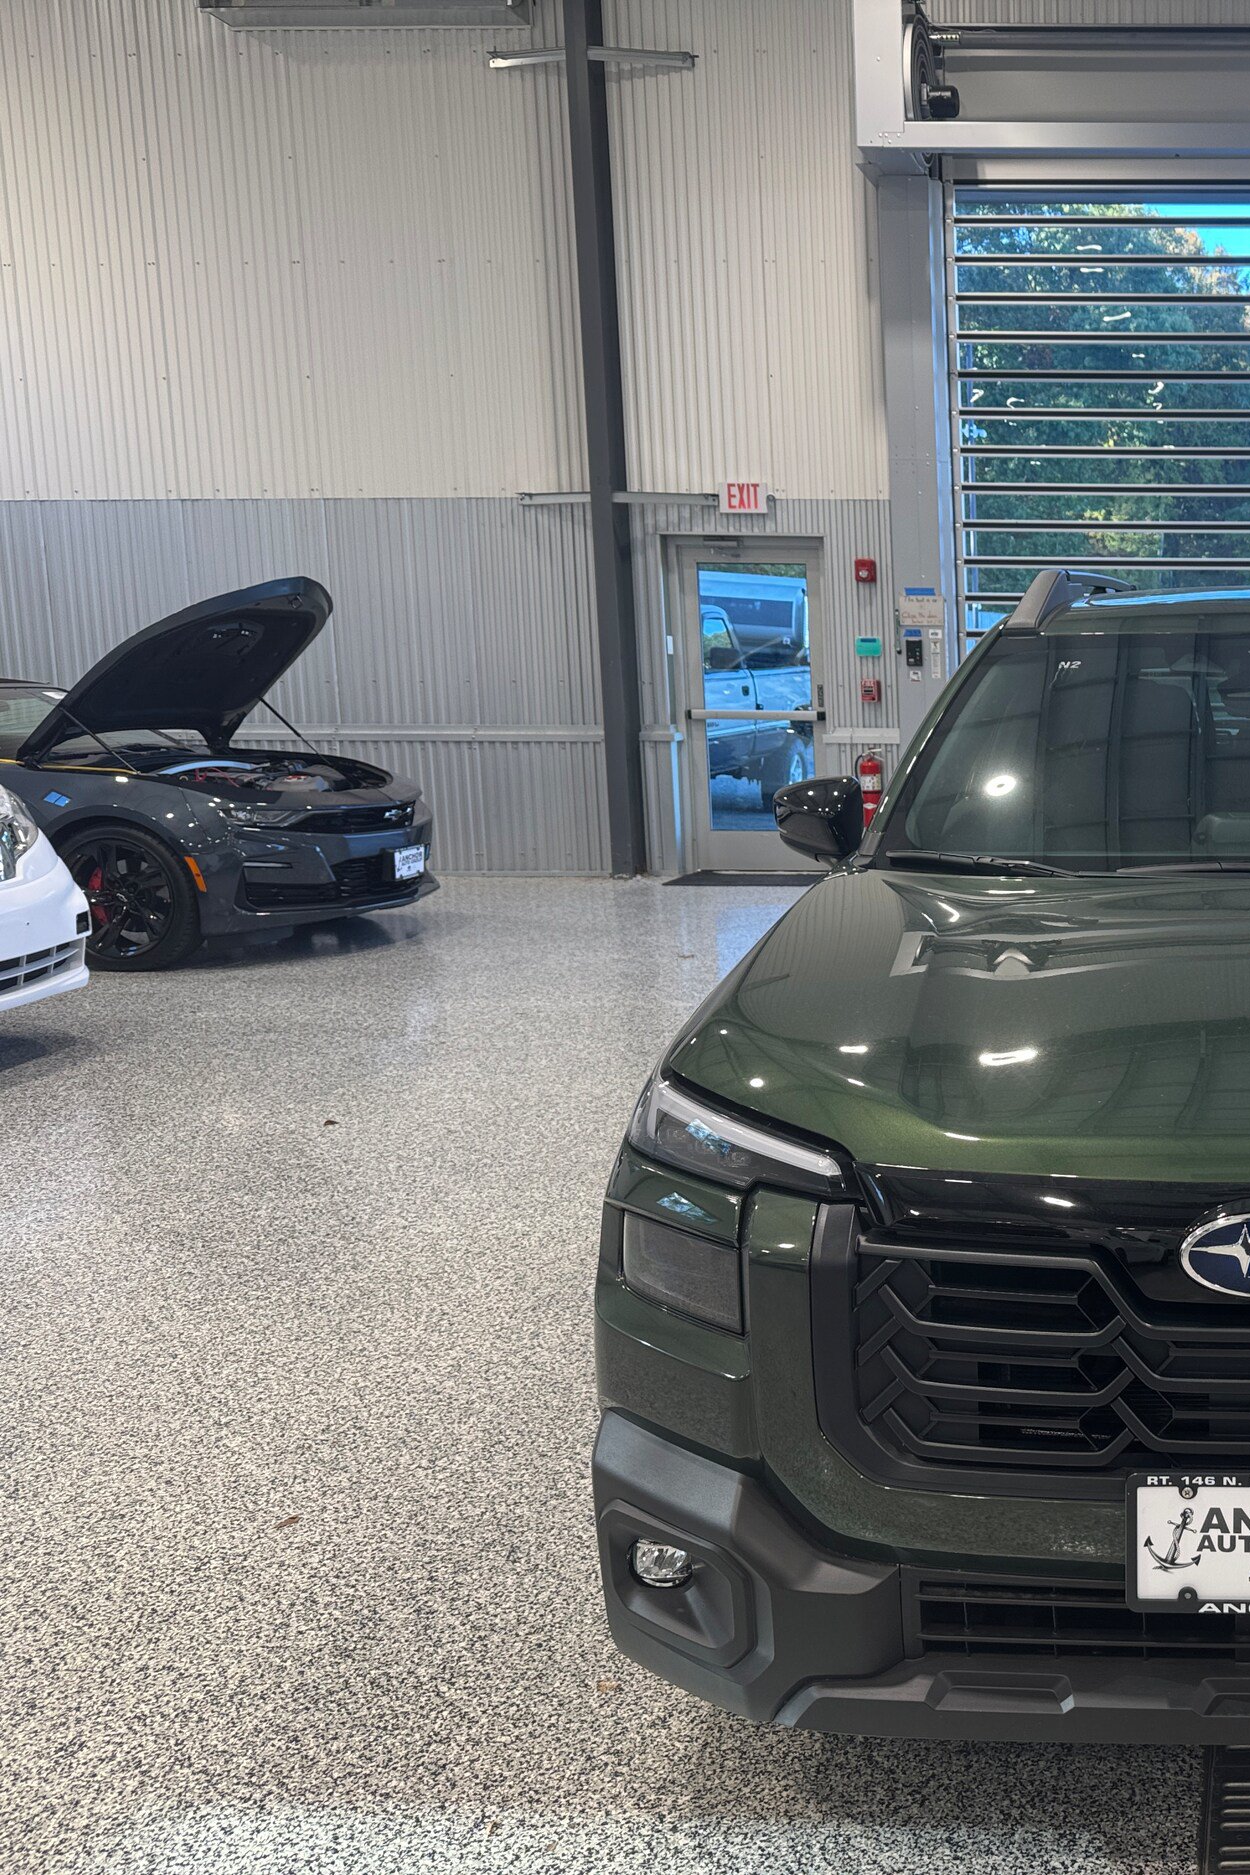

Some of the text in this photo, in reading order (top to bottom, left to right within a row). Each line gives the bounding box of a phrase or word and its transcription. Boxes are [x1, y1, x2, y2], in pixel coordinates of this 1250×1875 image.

[727, 483, 759, 509] EXIT
[1147, 1476, 1172, 1486] RT.
[1181, 1476, 1215, 1486] 146
[1223, 1477, 1242, 1486] N.
